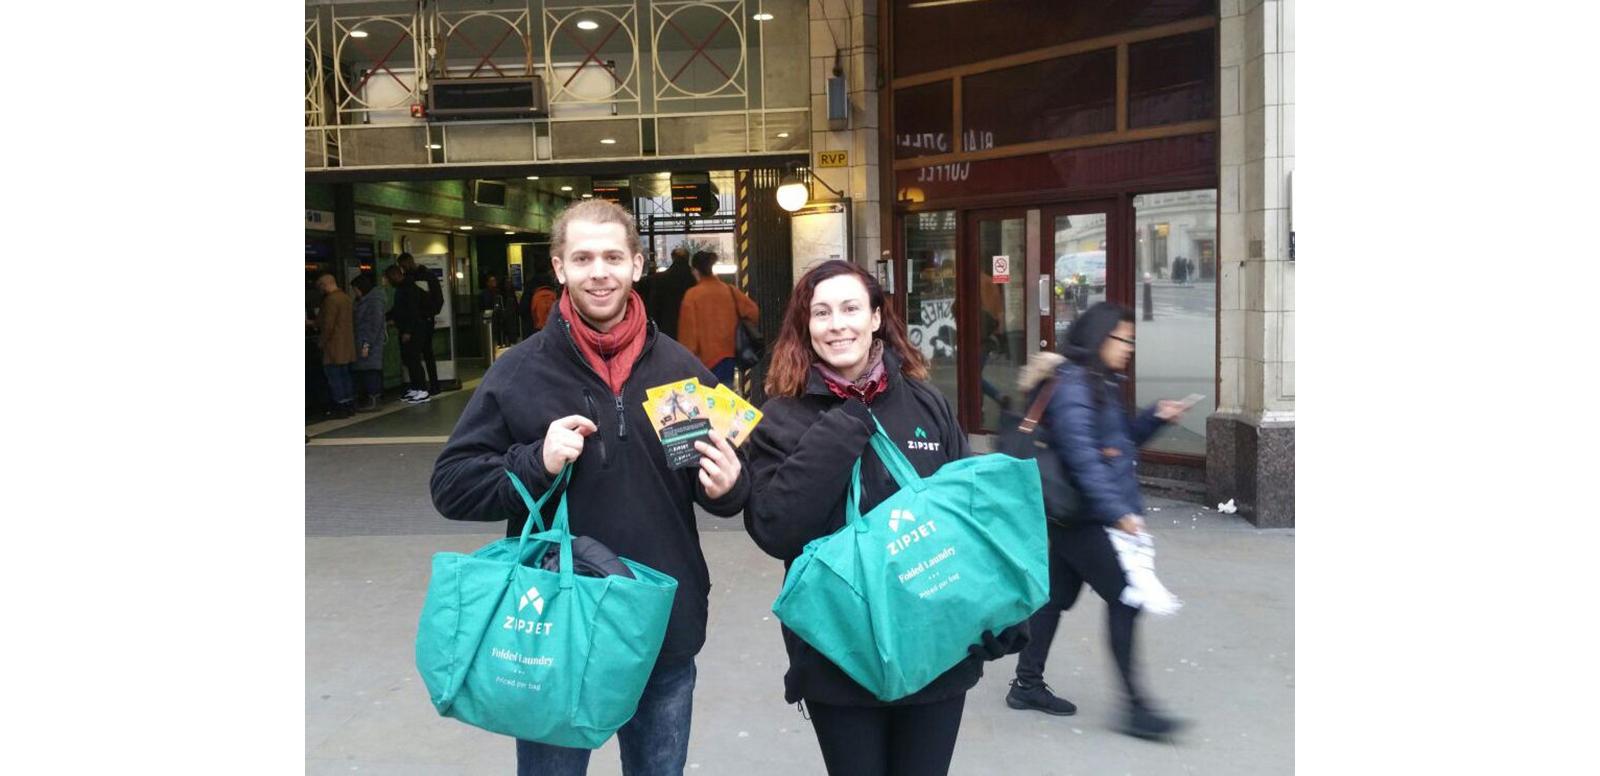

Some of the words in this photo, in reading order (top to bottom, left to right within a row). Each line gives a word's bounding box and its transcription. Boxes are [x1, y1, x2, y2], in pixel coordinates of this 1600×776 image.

[821, 153, 846, 165] RVP
[907, 440, 940, 451] ZIPJET
[886, 520, 937, 556] ZIPJET
[898, 562, 925, 584] Folded
[923, 546, 956, 569] Laundry
[503, 615, 553, 635] ZIPJET
[491, 647, 519, 662] Folded
[518, 654, 554, 667] Laundry
